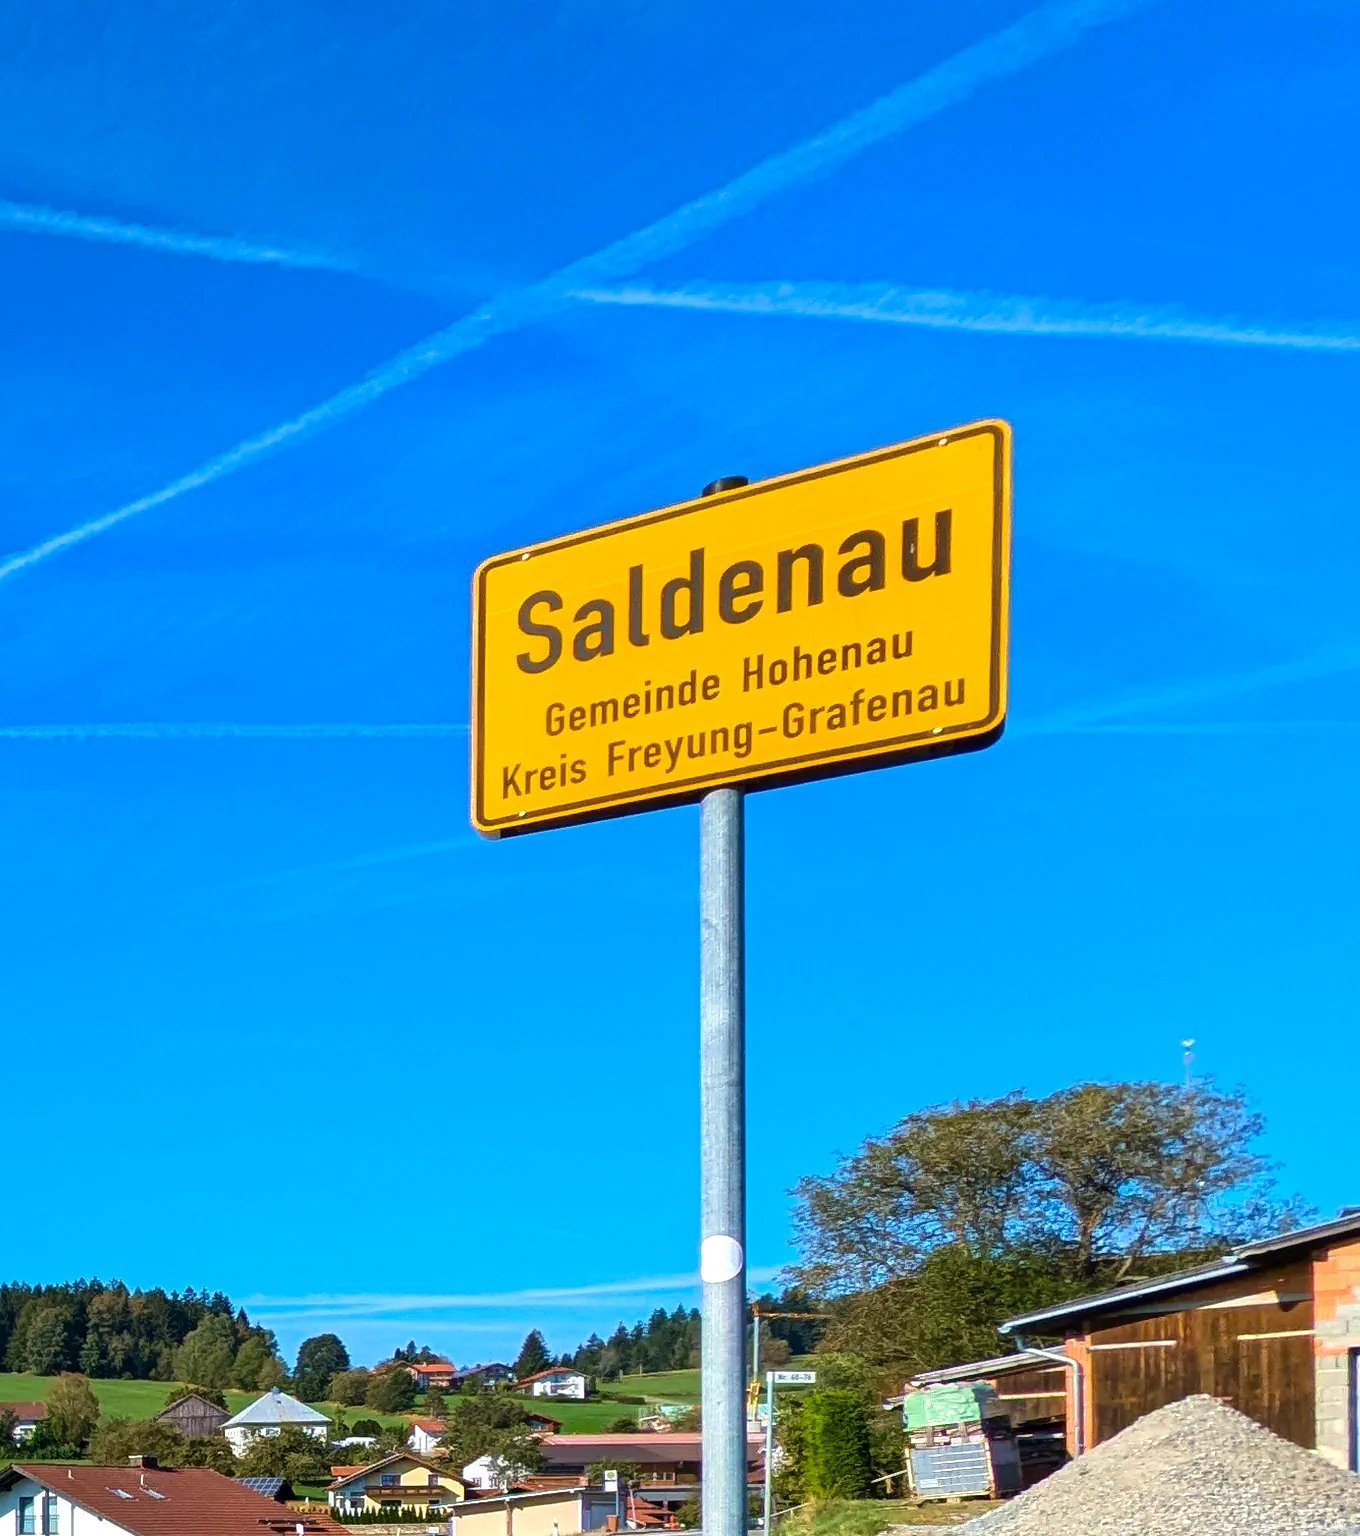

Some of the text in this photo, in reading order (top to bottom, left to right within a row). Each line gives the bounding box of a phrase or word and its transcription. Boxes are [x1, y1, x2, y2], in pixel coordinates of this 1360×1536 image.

[516, 508, 953, 675] Saldenau
[502, 677, 966, 799] Kreis Freyung-Grafenau
[545, 629, 914, 737] Gemeinde Hohenau
